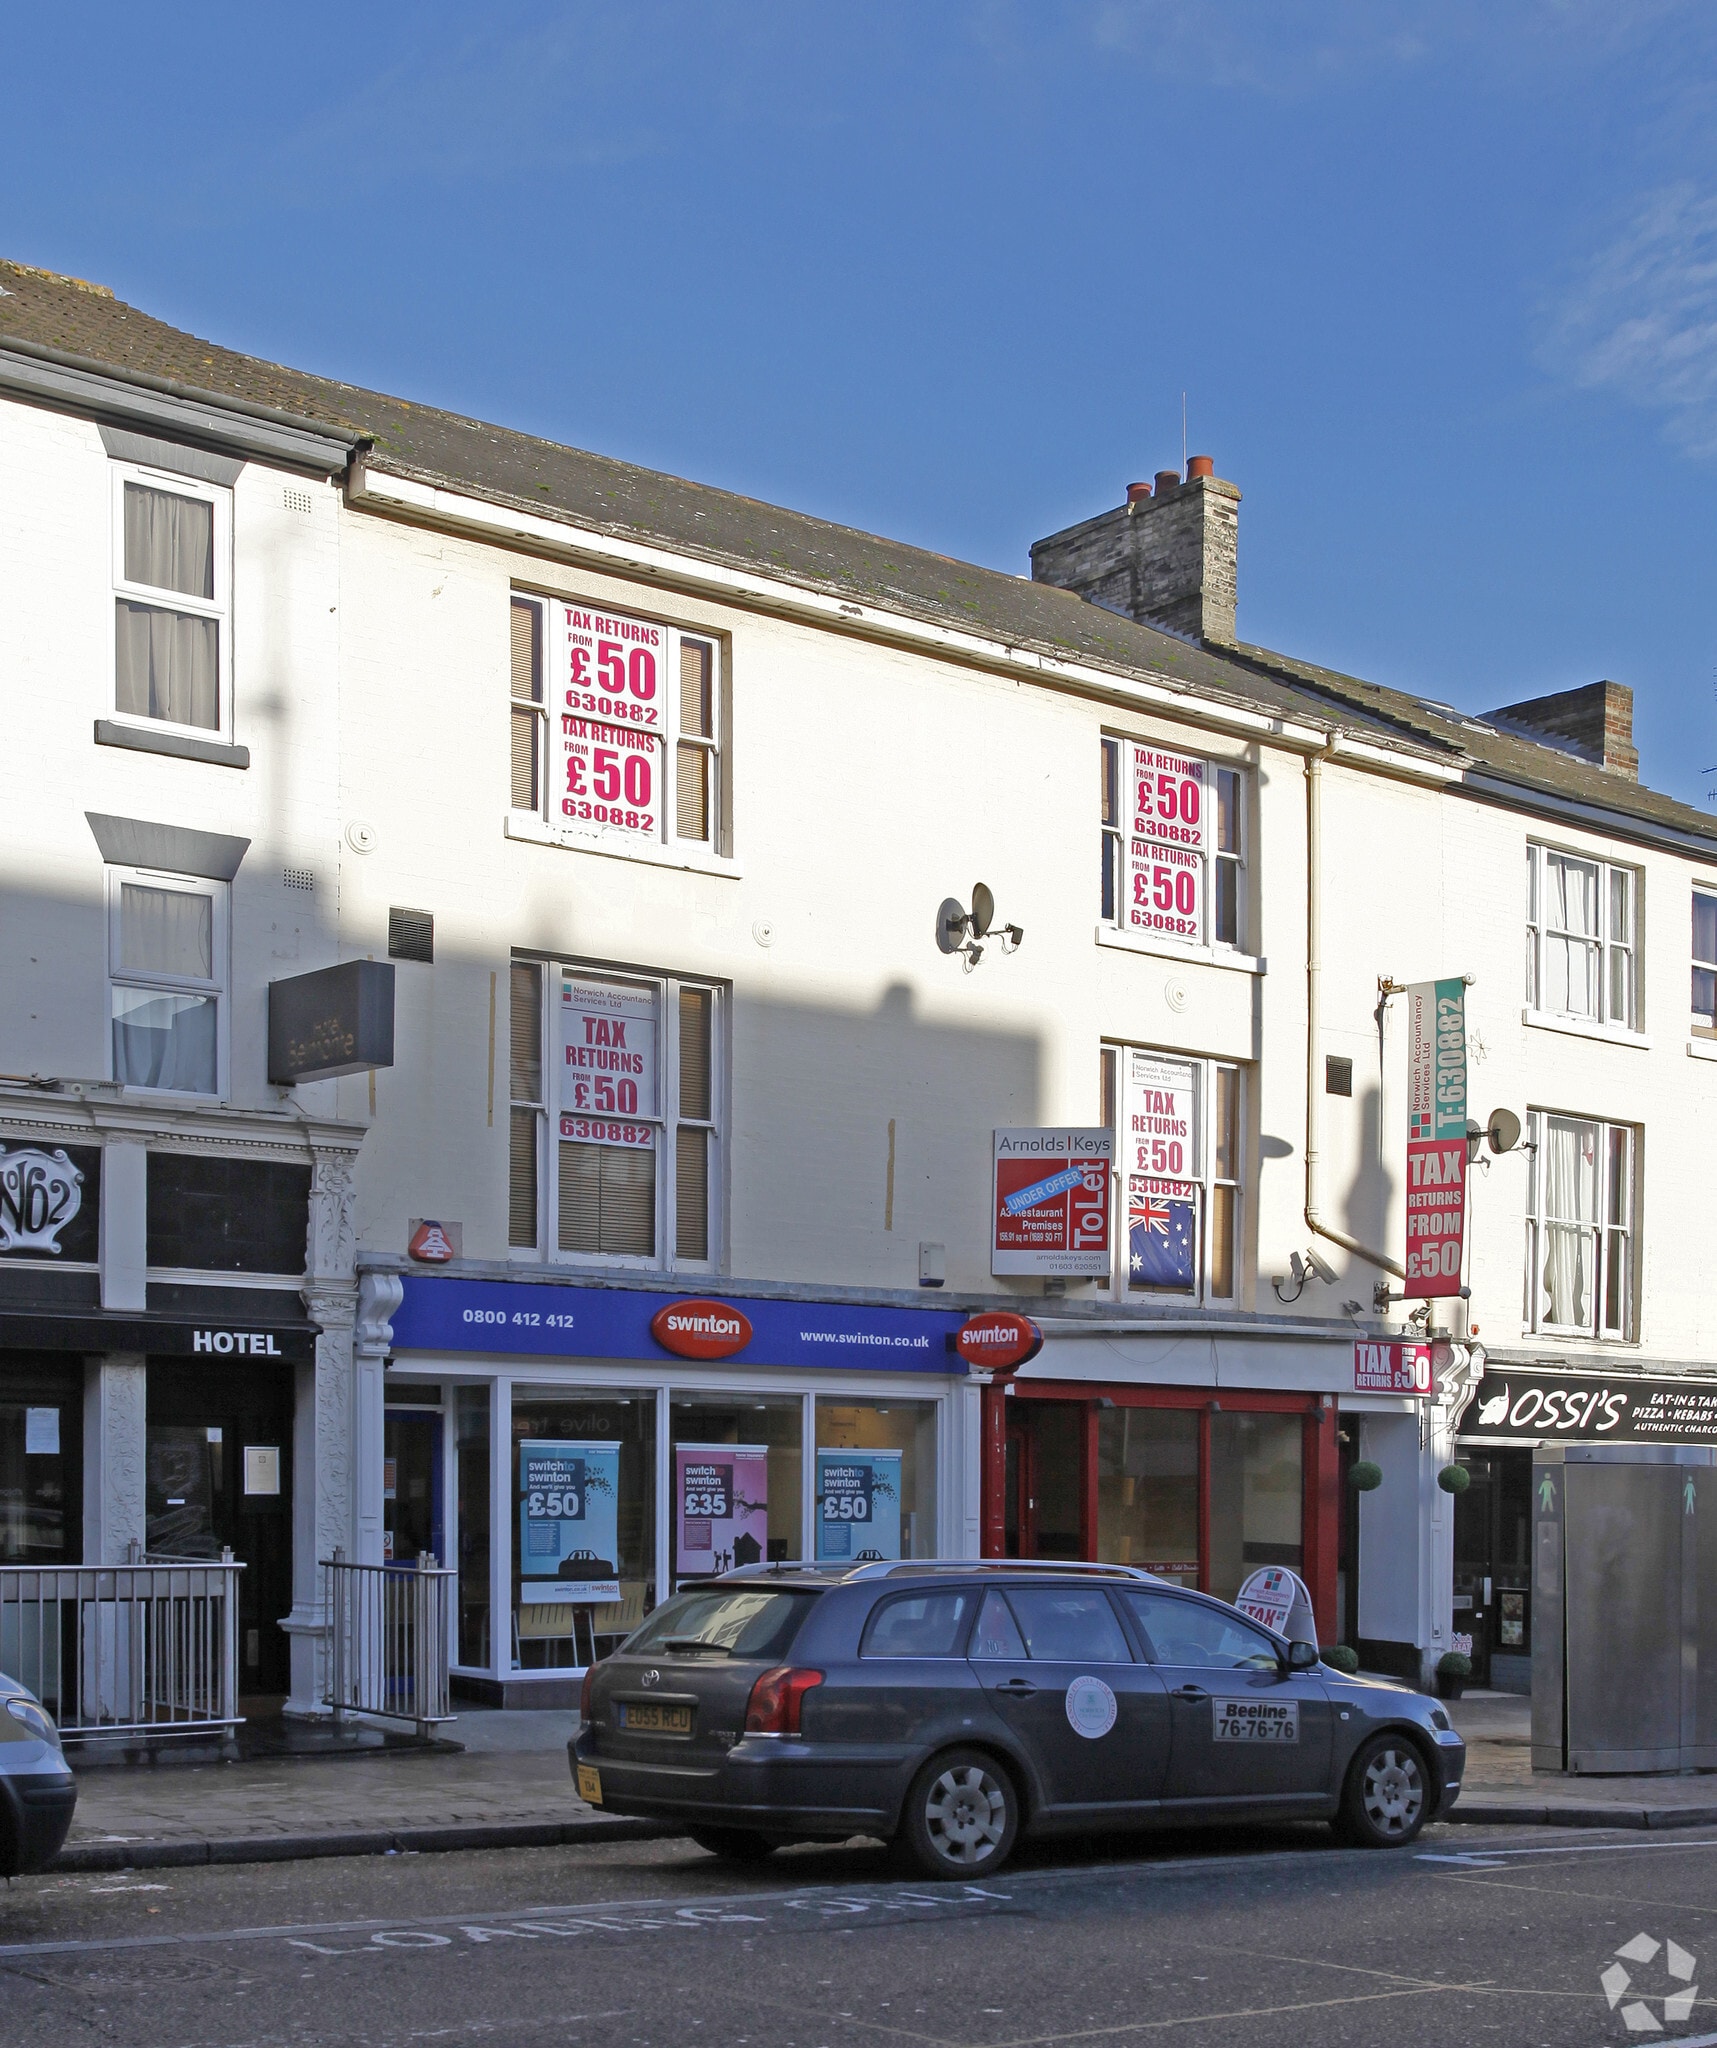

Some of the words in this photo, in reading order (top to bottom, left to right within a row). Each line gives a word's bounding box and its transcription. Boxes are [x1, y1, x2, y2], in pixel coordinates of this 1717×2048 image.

[565, 609, 592, 631] TAX
[596, 616, 659, 647] RETURNS
[568, 633, 593, 647] FROM
[571, 639, 656, 700] £50
[566, 690, 658, 725] 630882
[561, 716, 587, 740] TAX
[592, 722, 654, 753] RETURNS
[564, 741, 588, 755] FROM
[1134, 748, 1153, 766] TAX
[1156, 754, 1203, 779] RETURNS
[1136, 769, 1154, 780] FROM
[567, 747, 651, 807] £50
[1138, 774, 1200, 825] £50
[562, 798, 654, 832] 630882
[1135, 818, 1200, 845] 630882
[1131, 840, 1149, 858] TAX
[1152, 845, 1197, 868] RETURNS
[1132, 861, 1150, 872] FROM
[1134, 865, 1195, 915] £50
[1131, 910, 1197, 935] 630882
[574, 987, 604, 997] Norwich
[607, 992, 655, 1005] Accountancy
[574, 995, 606, 1006] Services
[582, 1016, 626, 1049] TAX
[1413, 995, 1422, 1063] Accountancy
[566, 1045, 643, 1074] RETURNS
[573, 1072, 590, 1082] FROM
[1422, 1063, 1431, 1109] Services
[575, 1076, 638, 1114] £50
[1143, 1090, 1175, 1116] TAX
[560, 1118, 651, 1145] 630882
[1132, 1115, 1187, 1137] RETURNS
[1137, 1139, 1182, 1174] £50
[1409, 1151, 1461, 1186] TAX
[1008, 1187, 1045, 1210] UNDER
[1045, 1171, 1080, 1193] OFFER
[1129, 1176, 1192, 1197] 630882
[1409, 1191, 1461, 1207] RETURNS
[1023, 1221, 1063, 1230] Premises
[1409, 1212, 1460, 1237] FROM
[1408, 1240, 1460, 1279] £50
[463, 1309, 506, 1324] 0800
[512, 1312, 540, 1326] 412
[546, 1315, 573, 1328] 412
[668, 1313, 740, 1334] swinton
[193, 1331, 281, 1355] HOTEL
[800, 1332, 929, 1348] www.swinton.co.uk
[963, 1325, 1018, 1344] swinton
[1357, 1344, 1391, 1373] TAX
[1357, 1374, 1391, 1387] RETURNS
[1394, 1356, 1430, 1390] £50
[1510, 1389, 1627, 1430] OSSI'S
[1651, 1393, 1688, 1405] EAT-IN
[1688, 1396, 1695, 1406] &
[1632, 1407, 1664, 1418] PIZZA
[1673, 1409, 1713, 1421] KEBABS
[1634, 1423, 1683, 1431] AUTHENTIC
[529, 1472, 570, 1482] swinton
[686, 1476, 721, 1484] swinton
[825, 1478, 860, 1487] swinton
[529, 1492, 578, 1516] £50
[686, 1494, 726, 1515] £35
[824, 1497, 867, 1519] £50
[1226, 1704, 1287, 1718] Beeline
[1219, 1719, 1293, 1738] 76-76-76
